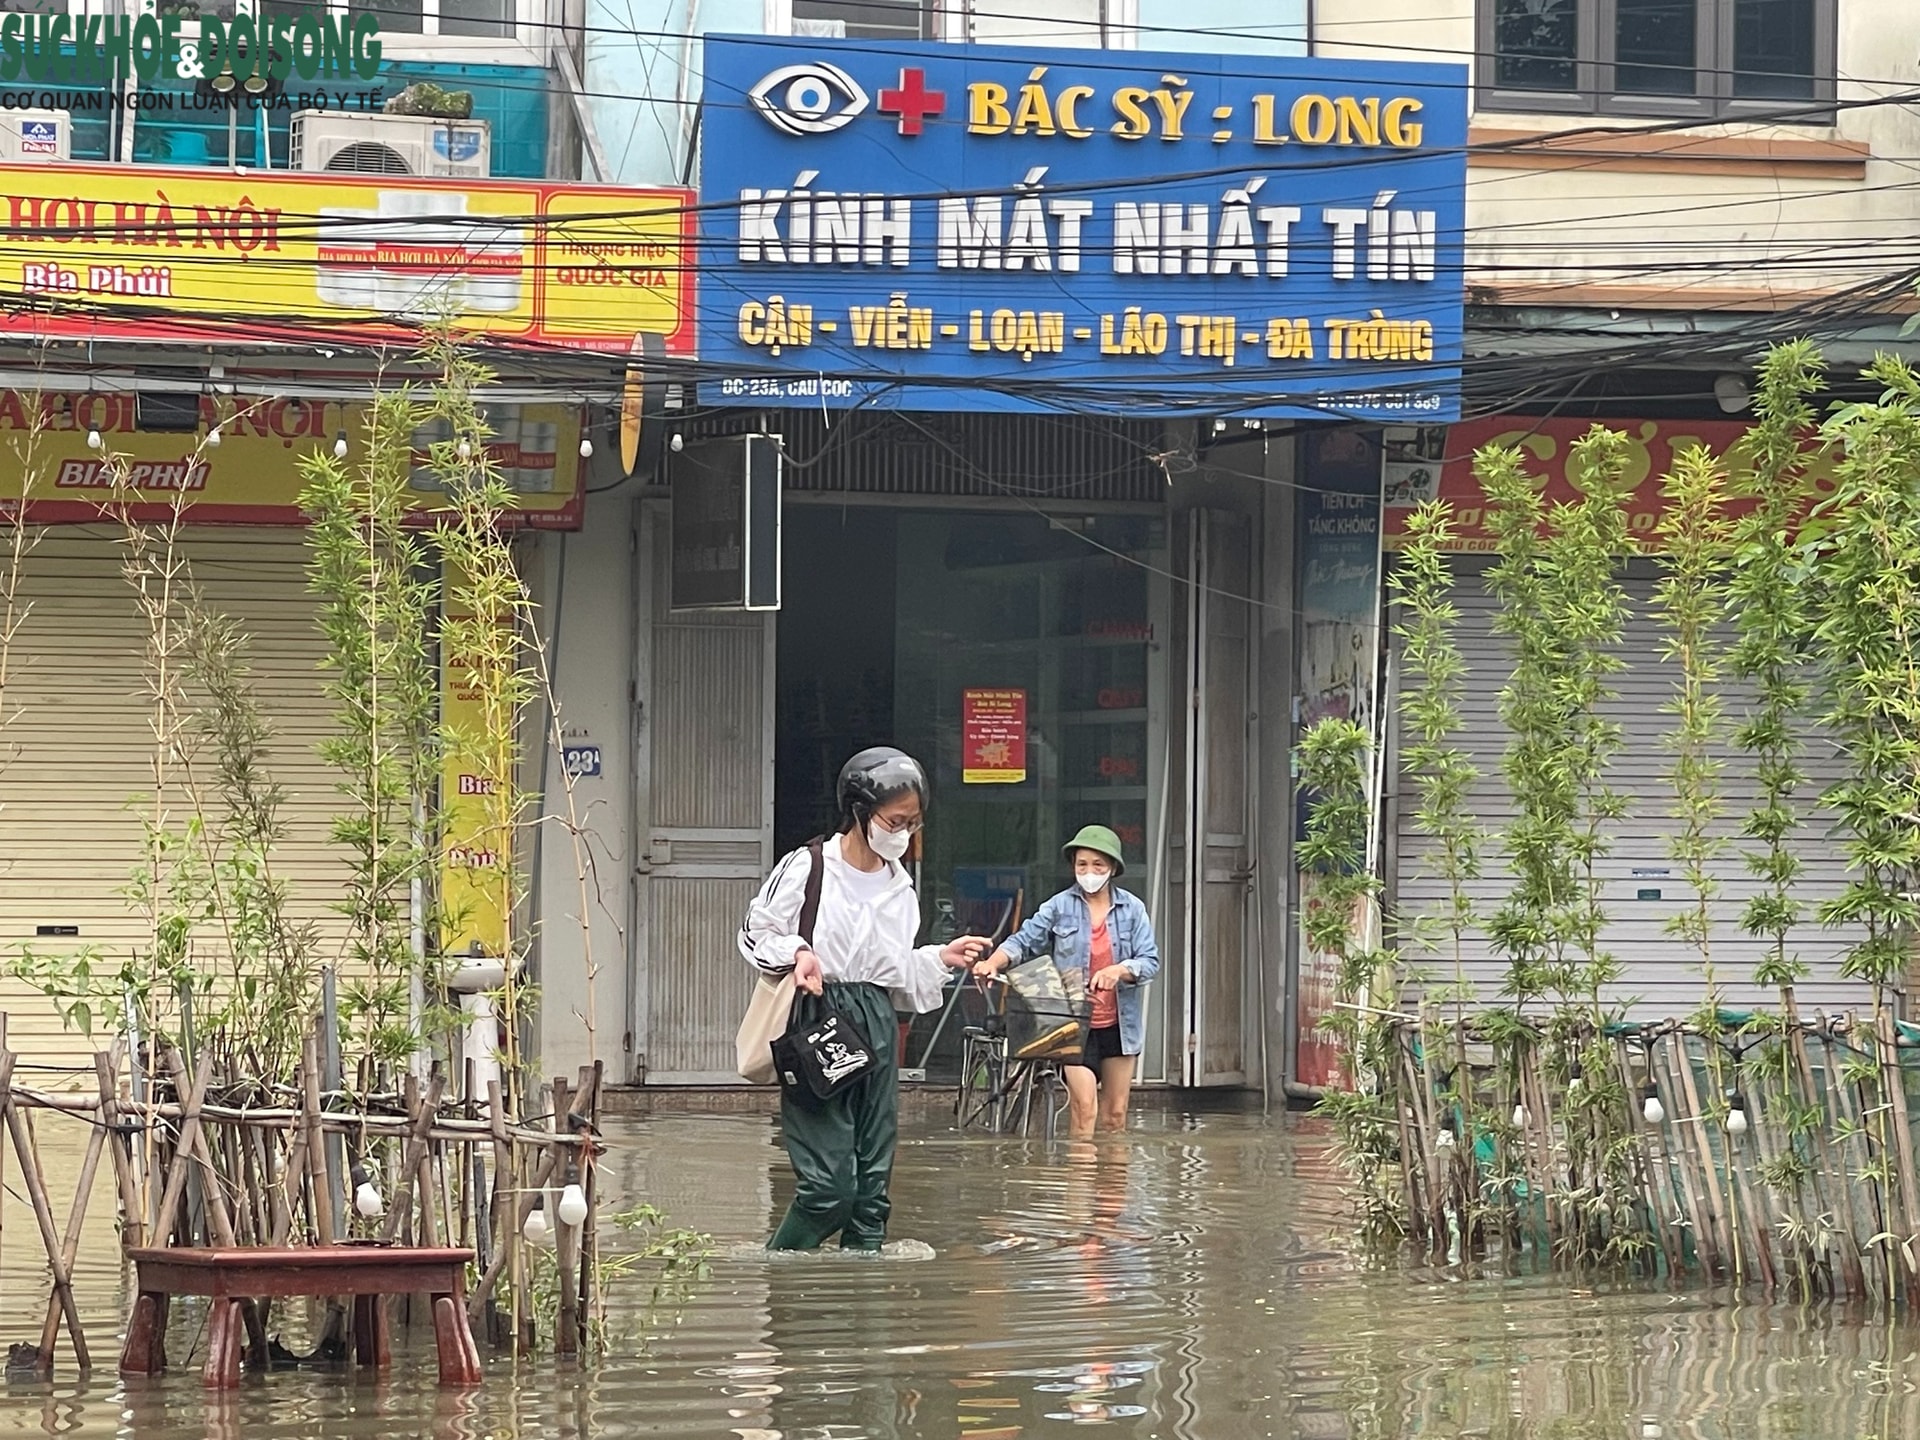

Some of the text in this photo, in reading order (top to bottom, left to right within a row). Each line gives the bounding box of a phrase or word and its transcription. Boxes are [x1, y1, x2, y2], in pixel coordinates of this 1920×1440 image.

[967, 66, 1095, 139] BÁC
[1110, 74, 1195, 142] SỸ
[1252, 93, 1425, 148] LONG
[6, 189, 282, 263] HƠI HÀ NỘI
[738, 166, 1437, 282] KÍNH MẮT NHẤT TÍN
[24, 263, 171, 297] Bia Phủi
[630, 267, 668, 287] GIA
[738, 294, 813, 357] CẬN
[849, 291, 933, 350] VIỄN
[969, 308, 1065, 362] LOẠN
[1100, 306, 1168, 355] LÃO
[1175, 314, 1236, 366] THỊ
[1264, 317, 1313, 360] ĐA
[1323, 309, 1434, 362] TRÒNG
[59, 461, 115, 487] BIA
